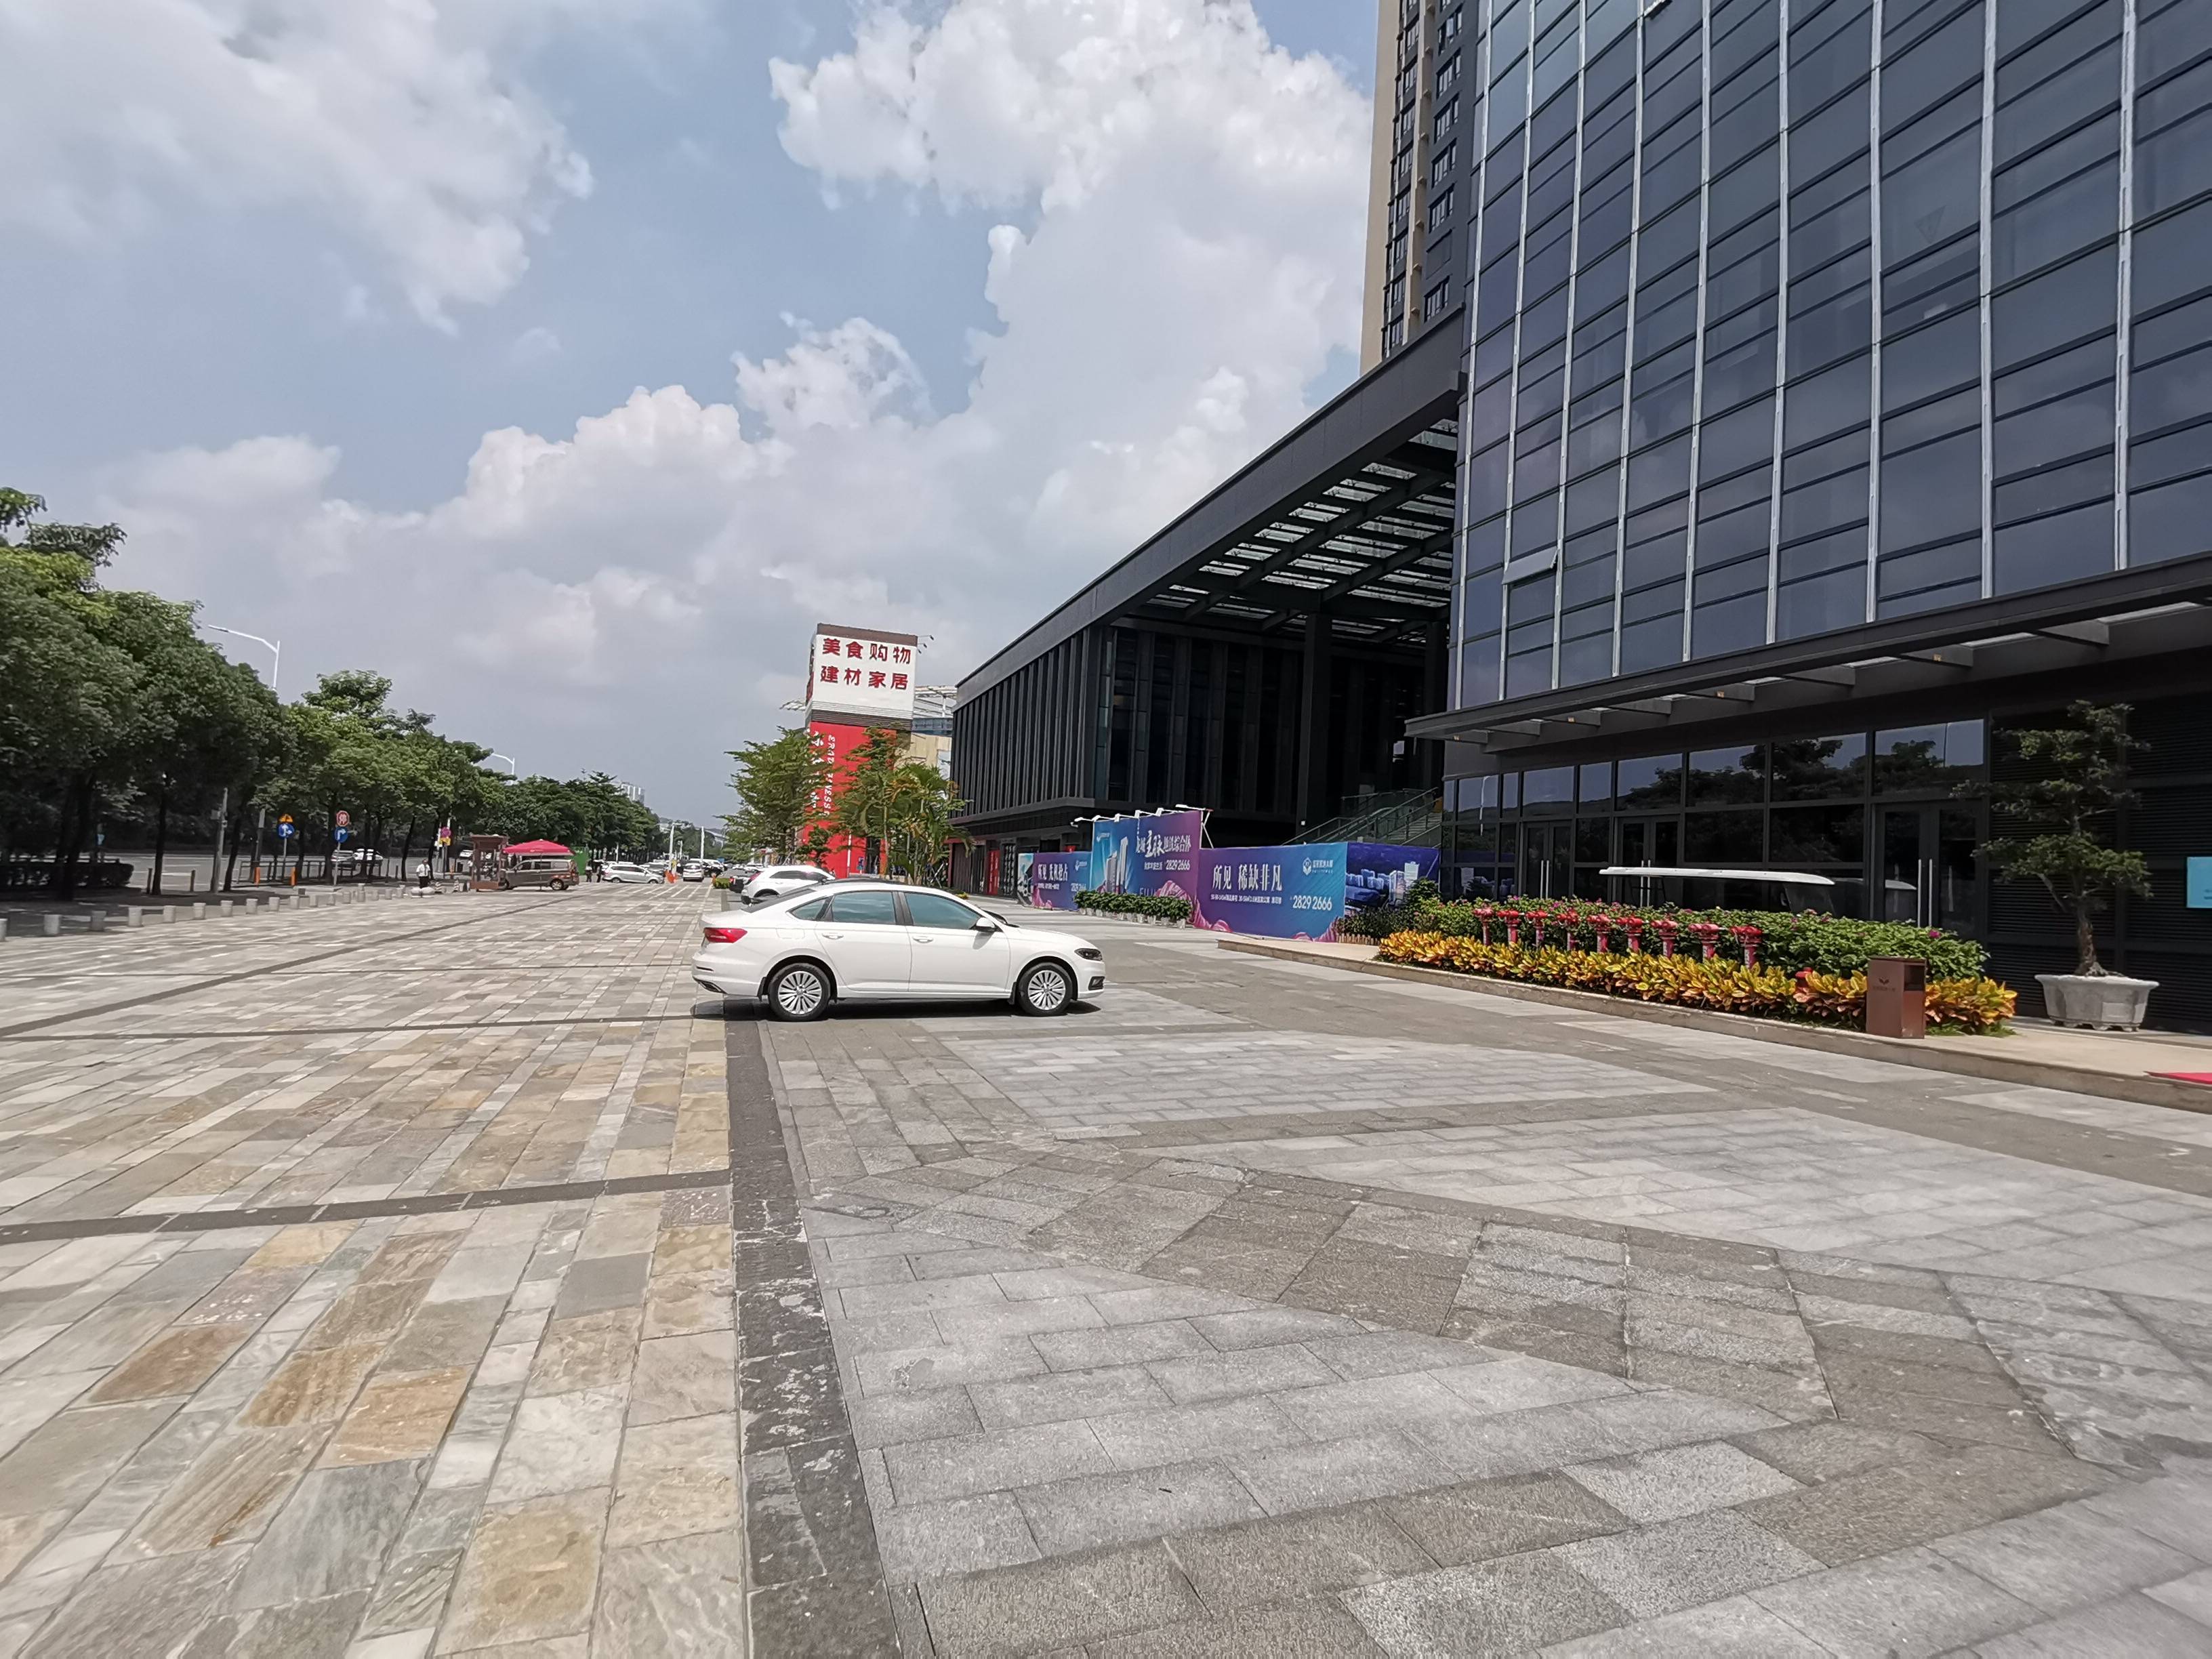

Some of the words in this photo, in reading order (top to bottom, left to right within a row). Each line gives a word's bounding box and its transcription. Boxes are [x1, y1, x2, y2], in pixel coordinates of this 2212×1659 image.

[822, 638, 911, 664] 美食购物
[820, 665, 908, 690] 建材家居
[1212, 864, 1232, 890] 所见
[1238, 863, 1282, 891] 稀缺非凡
[1292, 895, 1312, 909] 2829
[1312, 896, 1332, 911] 2666
